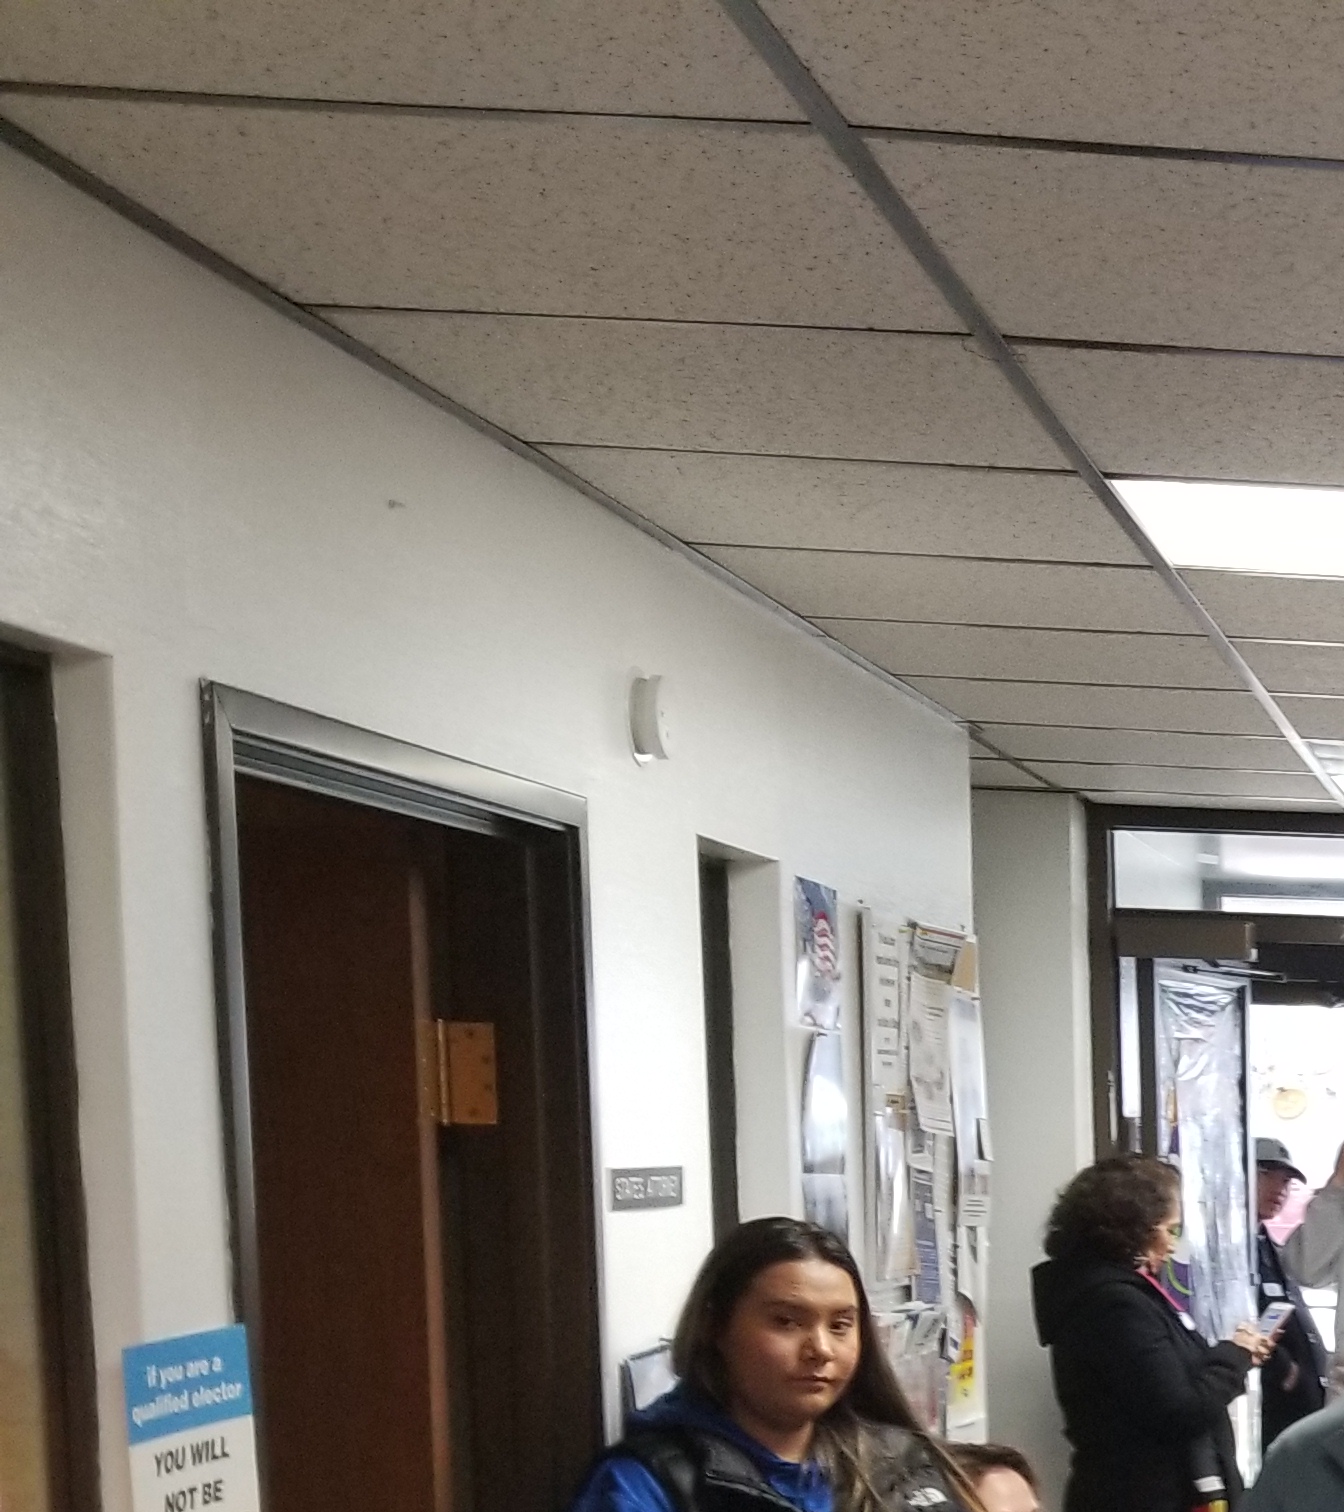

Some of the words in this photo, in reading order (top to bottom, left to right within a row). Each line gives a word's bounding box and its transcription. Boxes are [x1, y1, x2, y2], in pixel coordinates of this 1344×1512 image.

[159, 1364, 184, 1389] you
[186, 1358, 210, 1379] are
[211, 1355, 223, 1373] a
[131, 1388, 190, 1428] qualified
[191, 1380, 243, 1409] elector
[154, 1445, 186, 1477] YOU
[190, 1436, 230, 1466] WILL
[202, 1479, 223, 1506] BE
